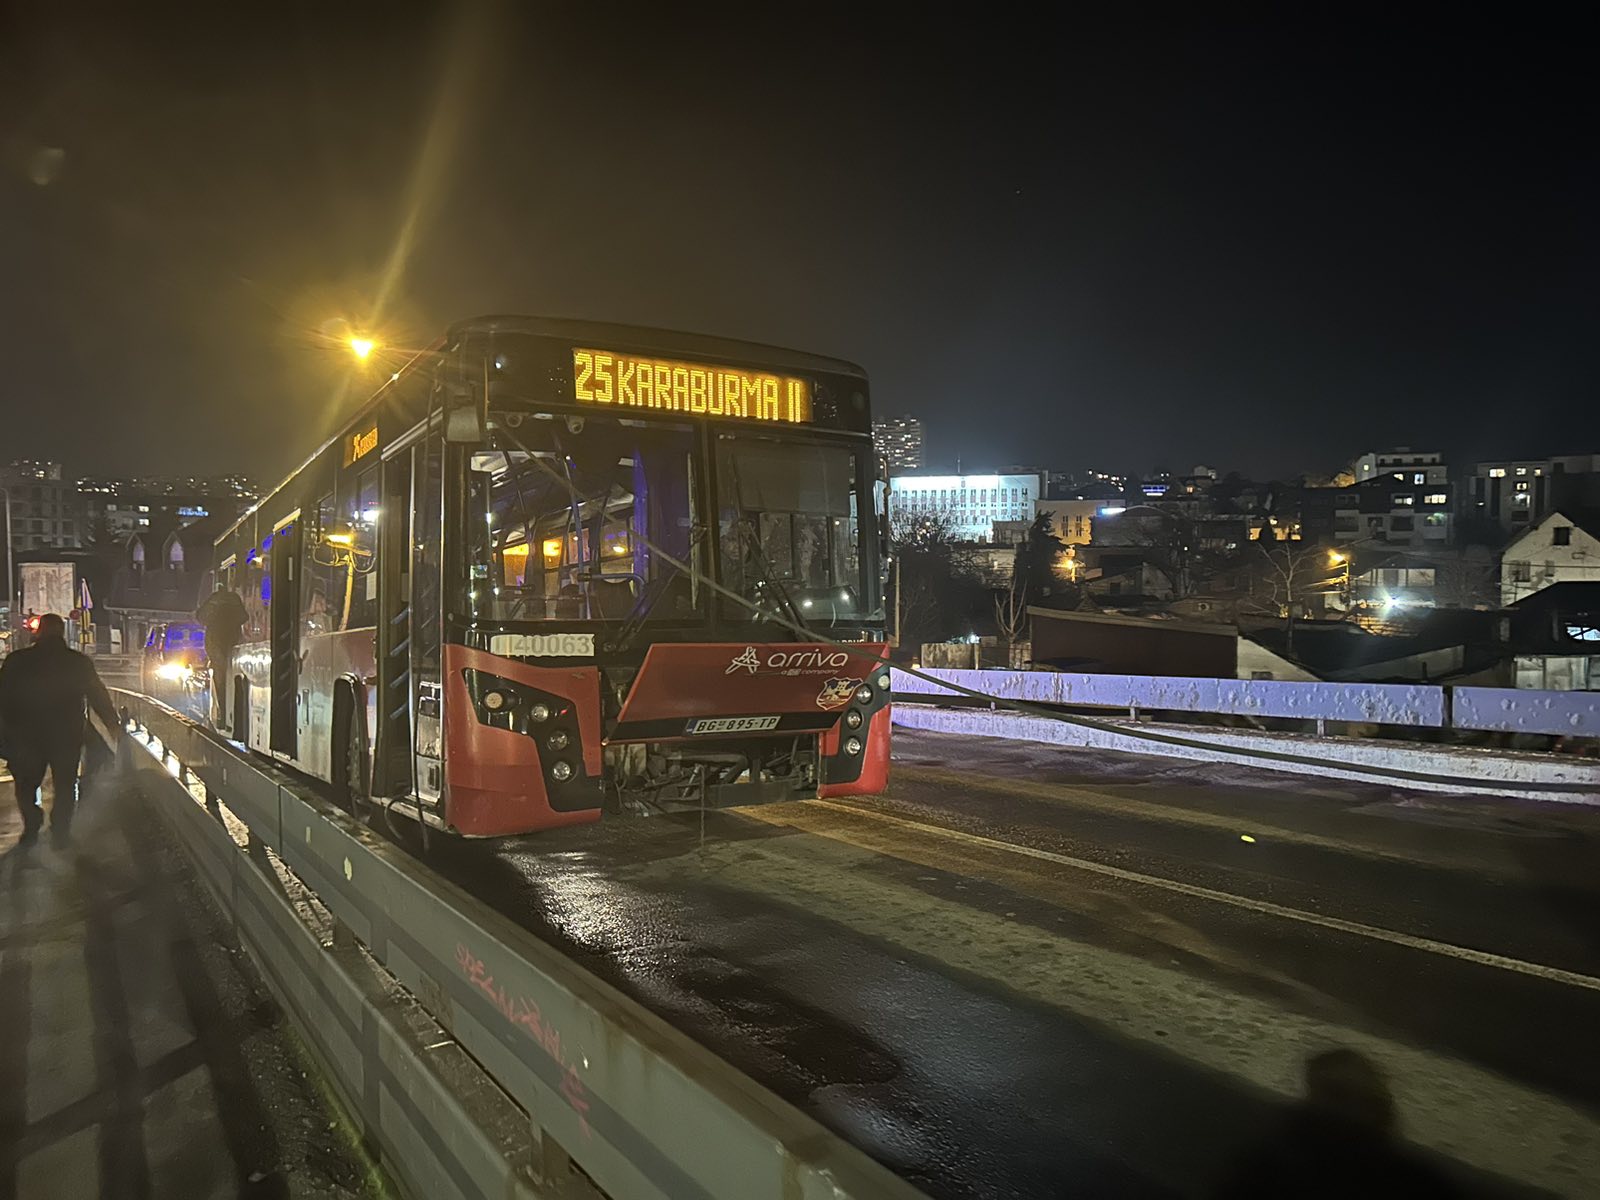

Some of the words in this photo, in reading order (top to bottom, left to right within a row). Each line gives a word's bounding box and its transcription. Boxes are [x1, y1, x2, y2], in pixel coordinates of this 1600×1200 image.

[575, 353, 613, 402] 25
[617, 361, 778, 421] KARABURMA
[767, 648, 849, 668] arriva
[696, 720, 717, 732] BG
